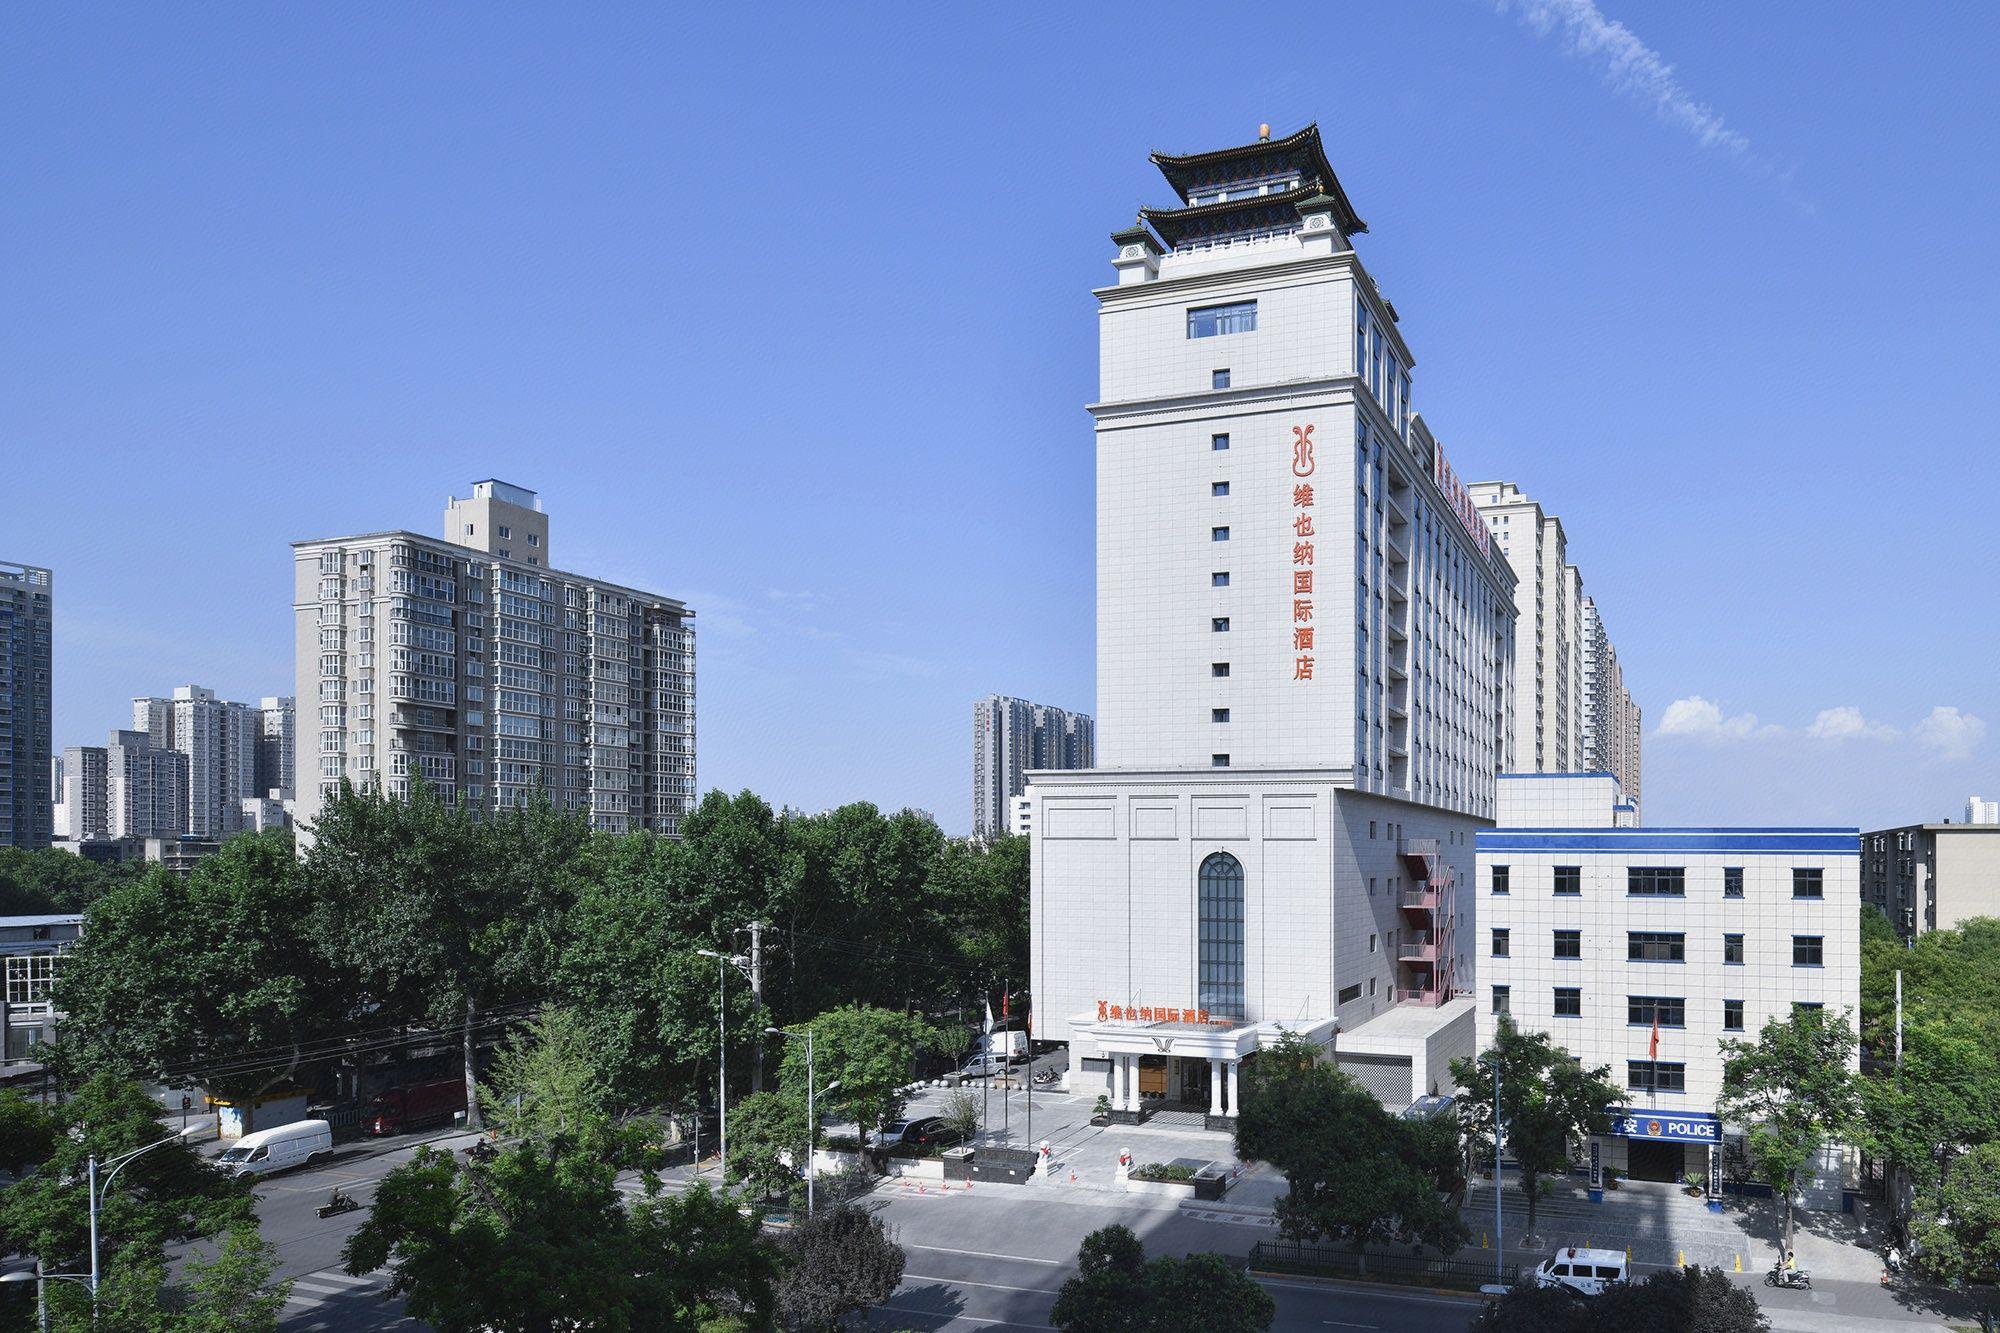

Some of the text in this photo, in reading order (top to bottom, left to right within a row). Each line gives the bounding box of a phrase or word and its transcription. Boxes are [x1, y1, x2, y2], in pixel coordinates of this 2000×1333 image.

[1293, 483, 1315, 680] 维也纳国际酒店
[1110, 1004, 1209, 1024] 维也纳国际酒店
[1668, 1122, 1715, 1137] POLICE
